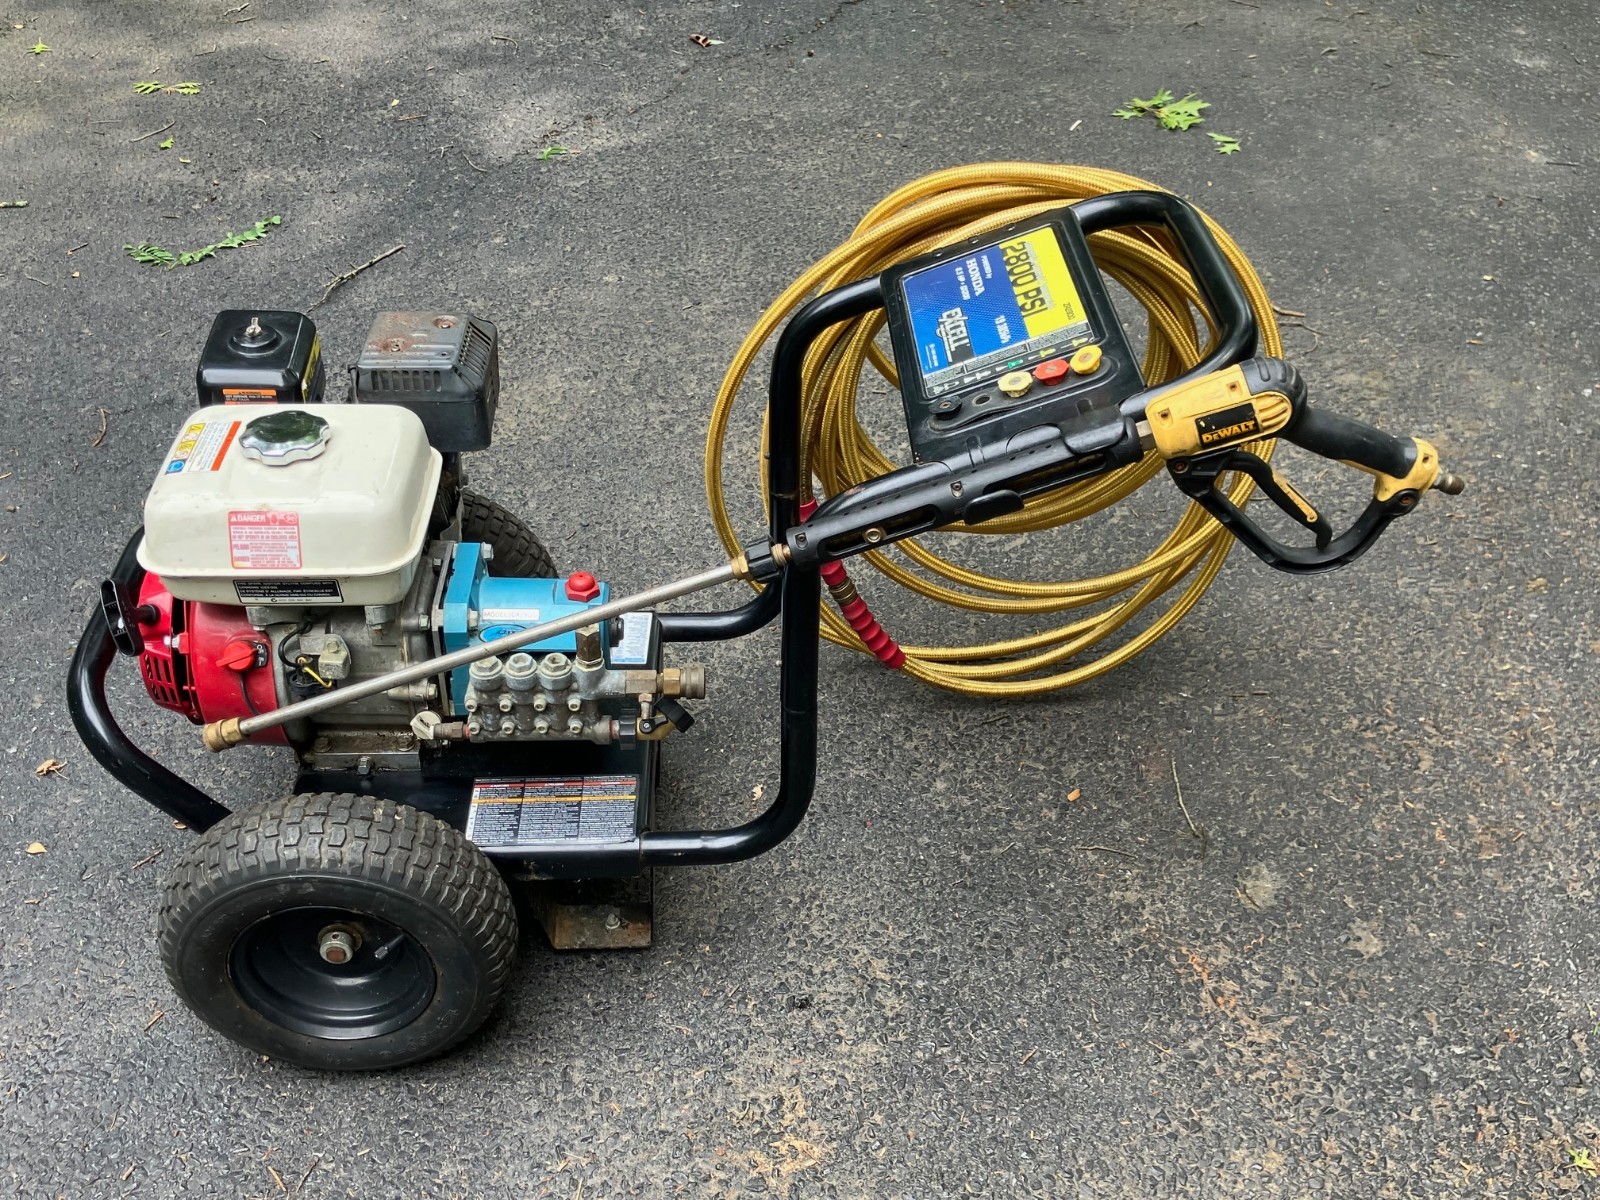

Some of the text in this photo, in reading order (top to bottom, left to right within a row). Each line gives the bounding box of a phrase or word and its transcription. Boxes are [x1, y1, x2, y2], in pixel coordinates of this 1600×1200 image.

[966, 257, 985, 296] HONDA
[1002, 241, 1049, 318] 2800 PSI
[938, 307, 969, 351] EXCELL
[238, 514, 265, 523] DANGER
